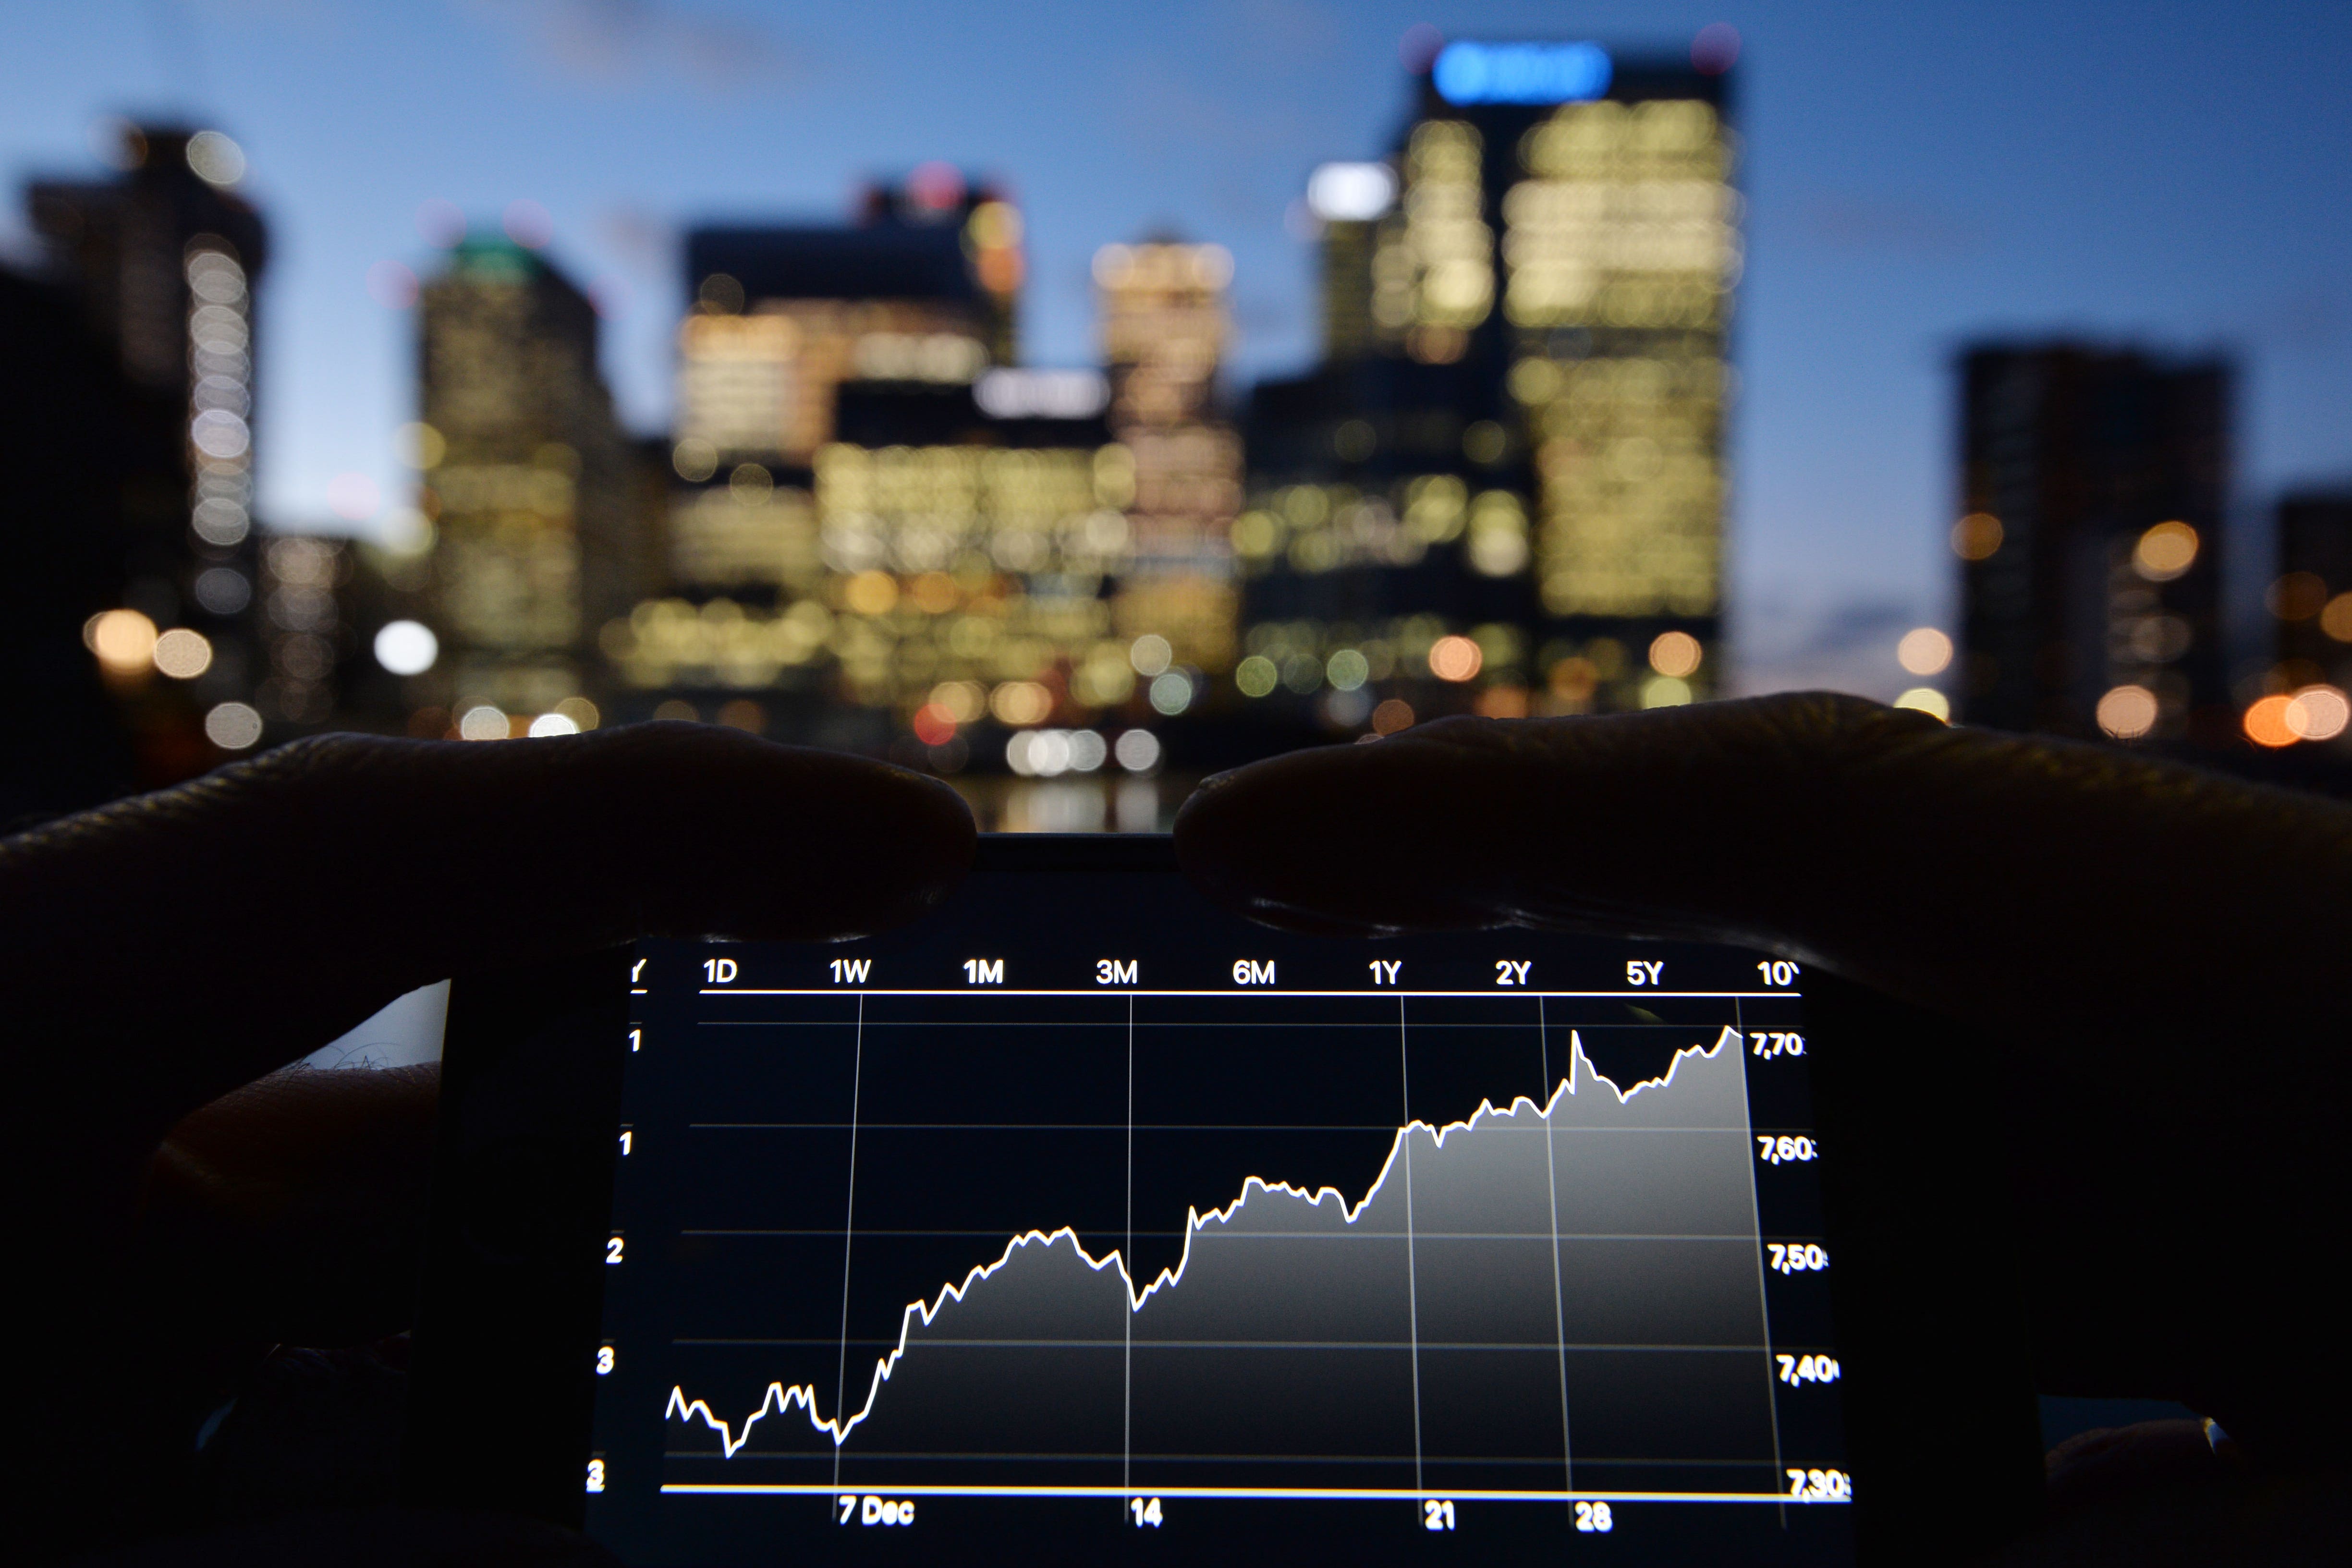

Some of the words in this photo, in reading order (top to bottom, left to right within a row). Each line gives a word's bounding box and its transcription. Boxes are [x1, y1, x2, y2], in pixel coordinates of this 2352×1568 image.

[703, 959, 737, 984] 1D
[830, 959, 871, 984] 1W
[963, 959, 1003, 985] 1M
[1097, 960, 1137, 985] 3M
[1233, 960, 1275, 985] 6M
[1369, 960, 1402, 985] 1Y
[1496, 960, 1532, 985] 2Y
[1627, 961, 1665, 986] 5Y
[1750, 1032, 1806, 1060] 7,70
[1757, 1136, 1819, 1166] 7,60
[606, 1237, 624, 1264] 2
[1767, 1243, 1830, 1276] 7,50
[596, 1346, 614, 1375] 3
[1776, 1354, 1841, 1388] 7,40
[1786, 1469, 1852, 1503] 7,30
[839, 1495, 856, 1525] 7
[862, 1495, 914, 1525] Dec
[1131, 1497, 1163, 1527] 14
[1424, 1499, 1455, 1531] 21
[1575, 1501, 1613, 1532] 28
